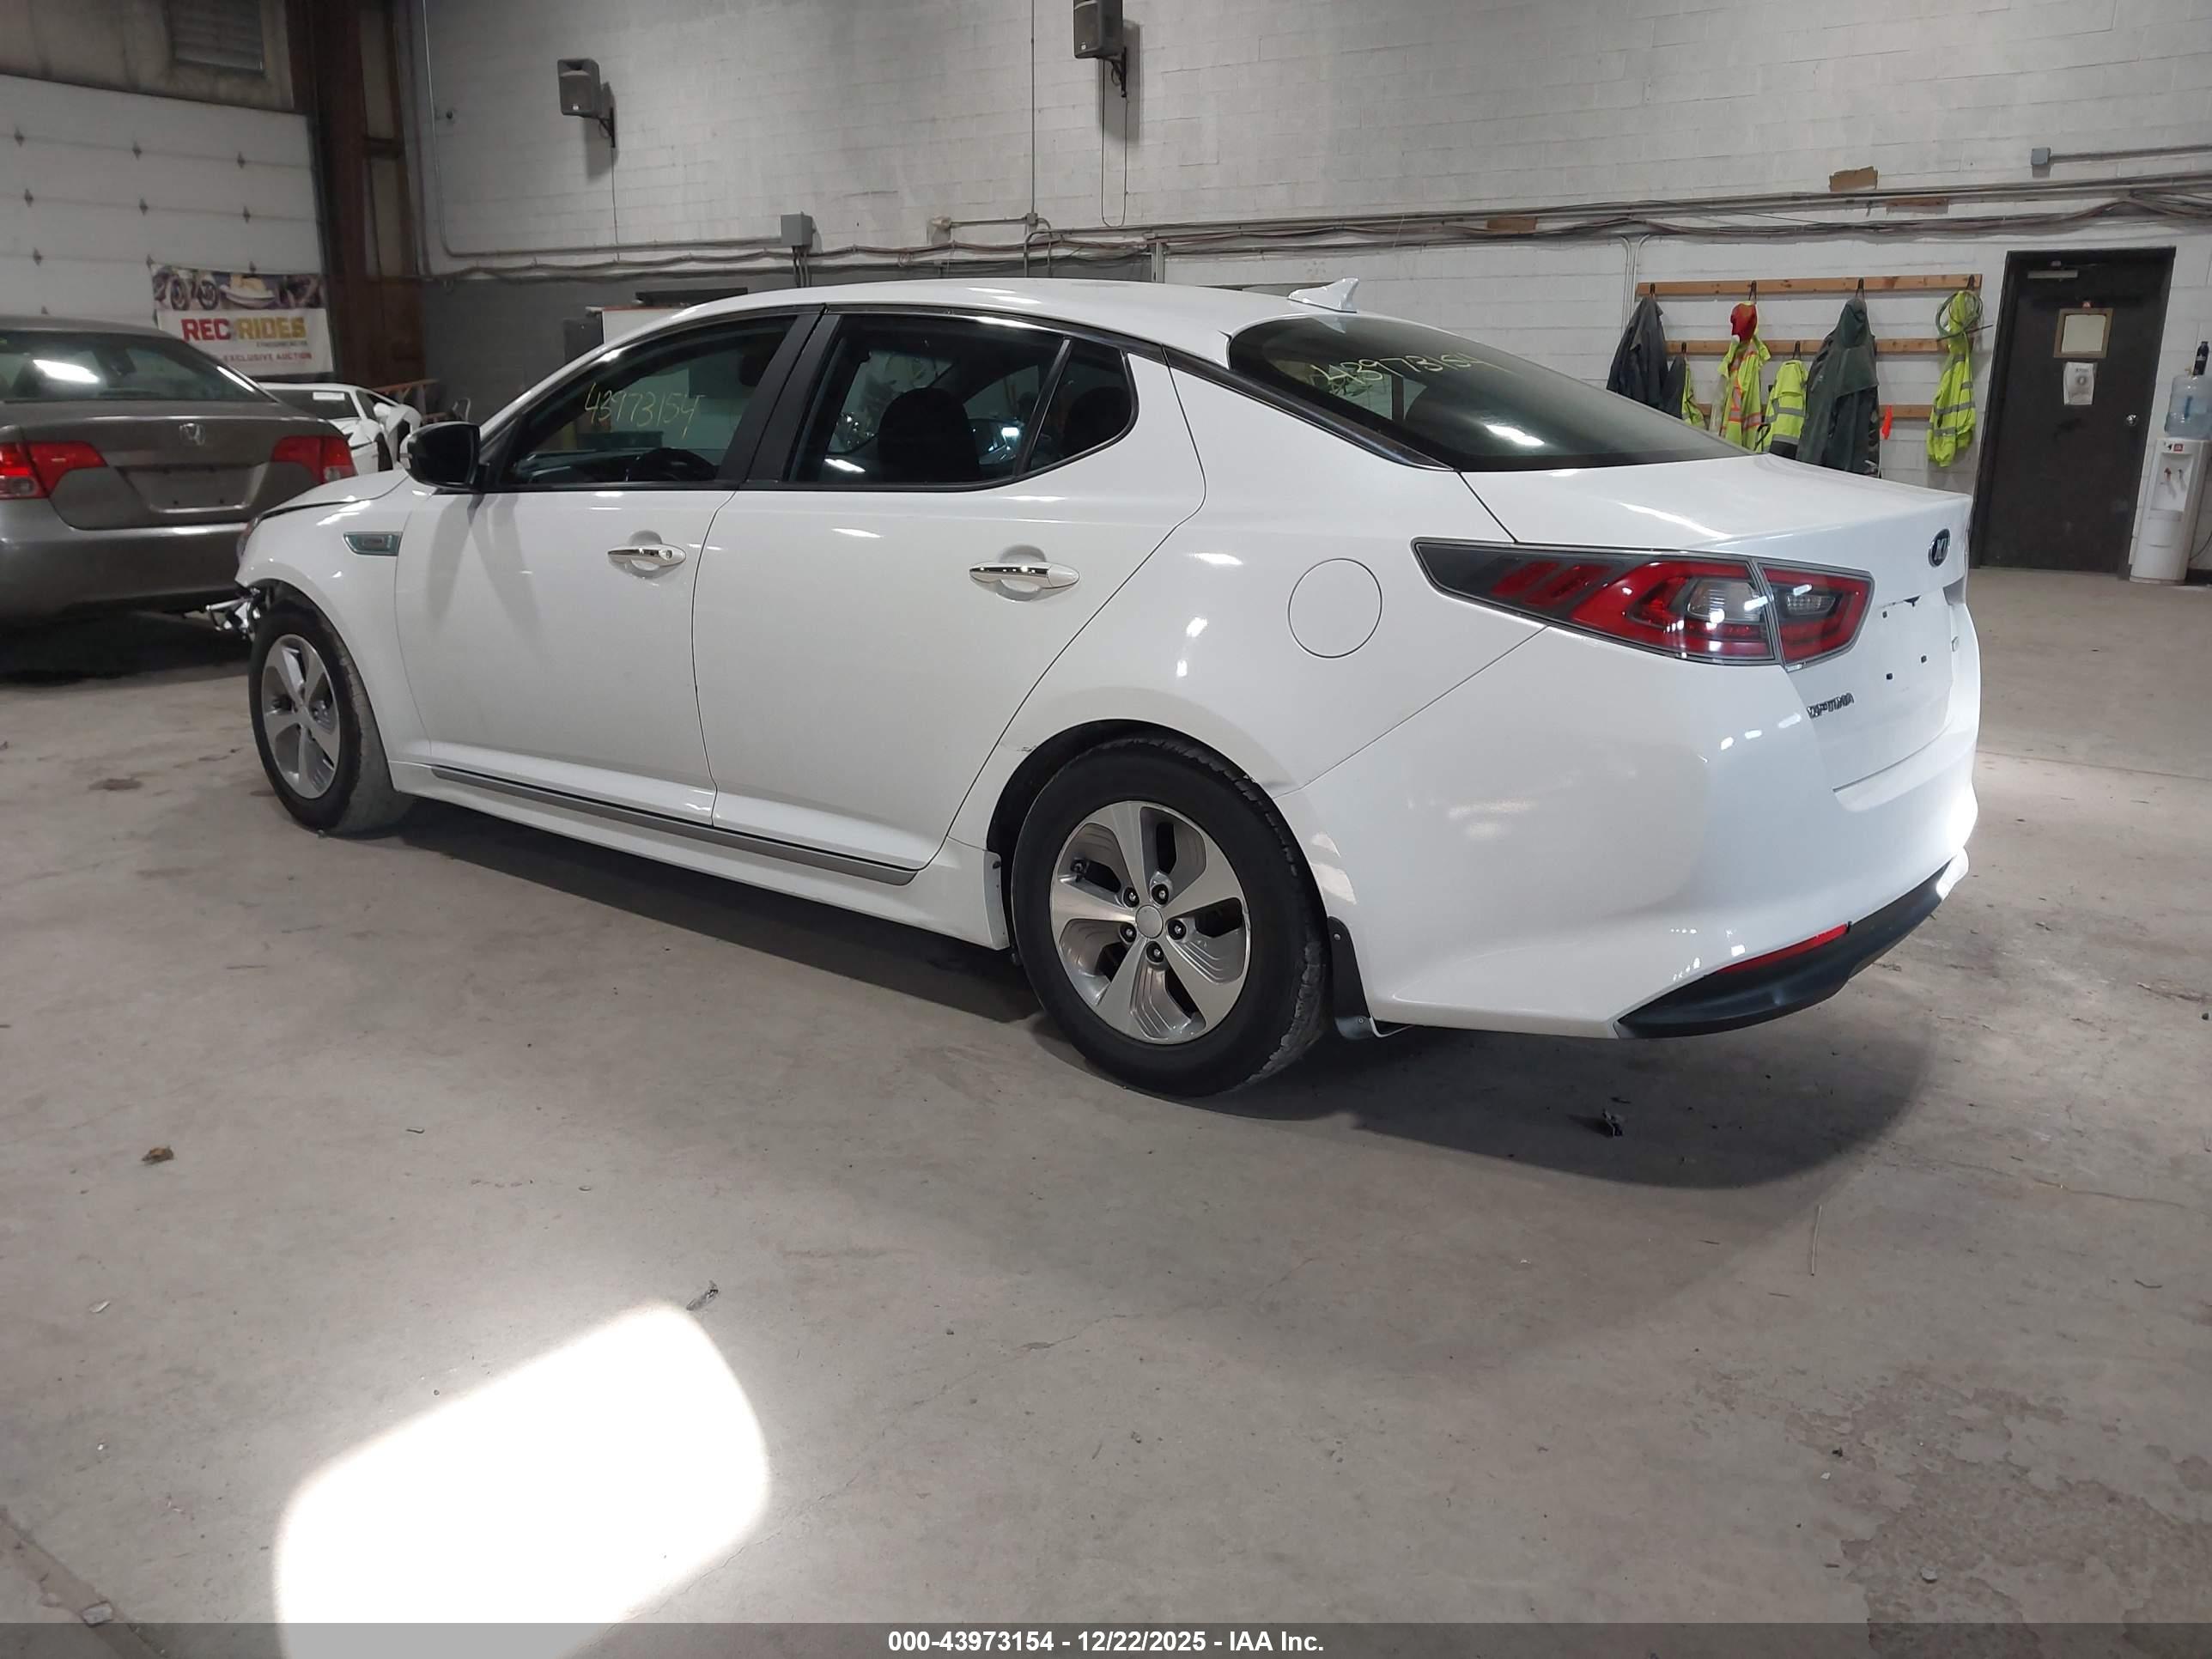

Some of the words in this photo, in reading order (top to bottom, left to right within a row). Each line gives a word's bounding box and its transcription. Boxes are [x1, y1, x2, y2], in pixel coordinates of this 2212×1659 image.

[181, 318, 231, 342] REC
[236, 316, 307, 341] RIDES
[276, 351, 312, 362] AUCTION
[584, 382, 707, 439] 43973154
